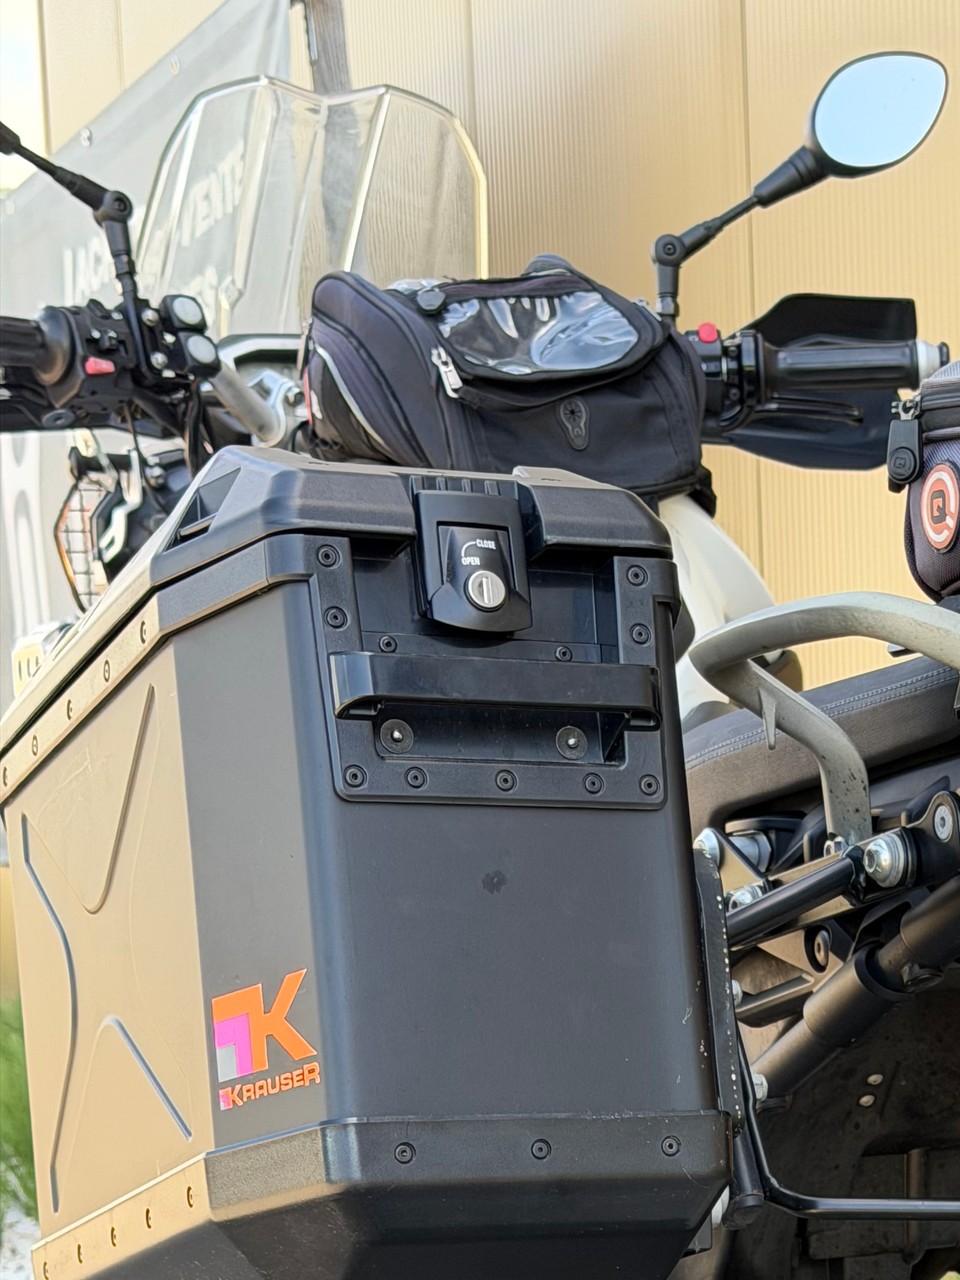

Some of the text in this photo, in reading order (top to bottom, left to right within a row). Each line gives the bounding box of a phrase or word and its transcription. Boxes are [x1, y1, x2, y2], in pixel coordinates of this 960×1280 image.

[476, 538, 496, 550] CLOSE
[461, 556, 480, 566] OPEN
[219, 1061, 321, 1111] KRAUSER
